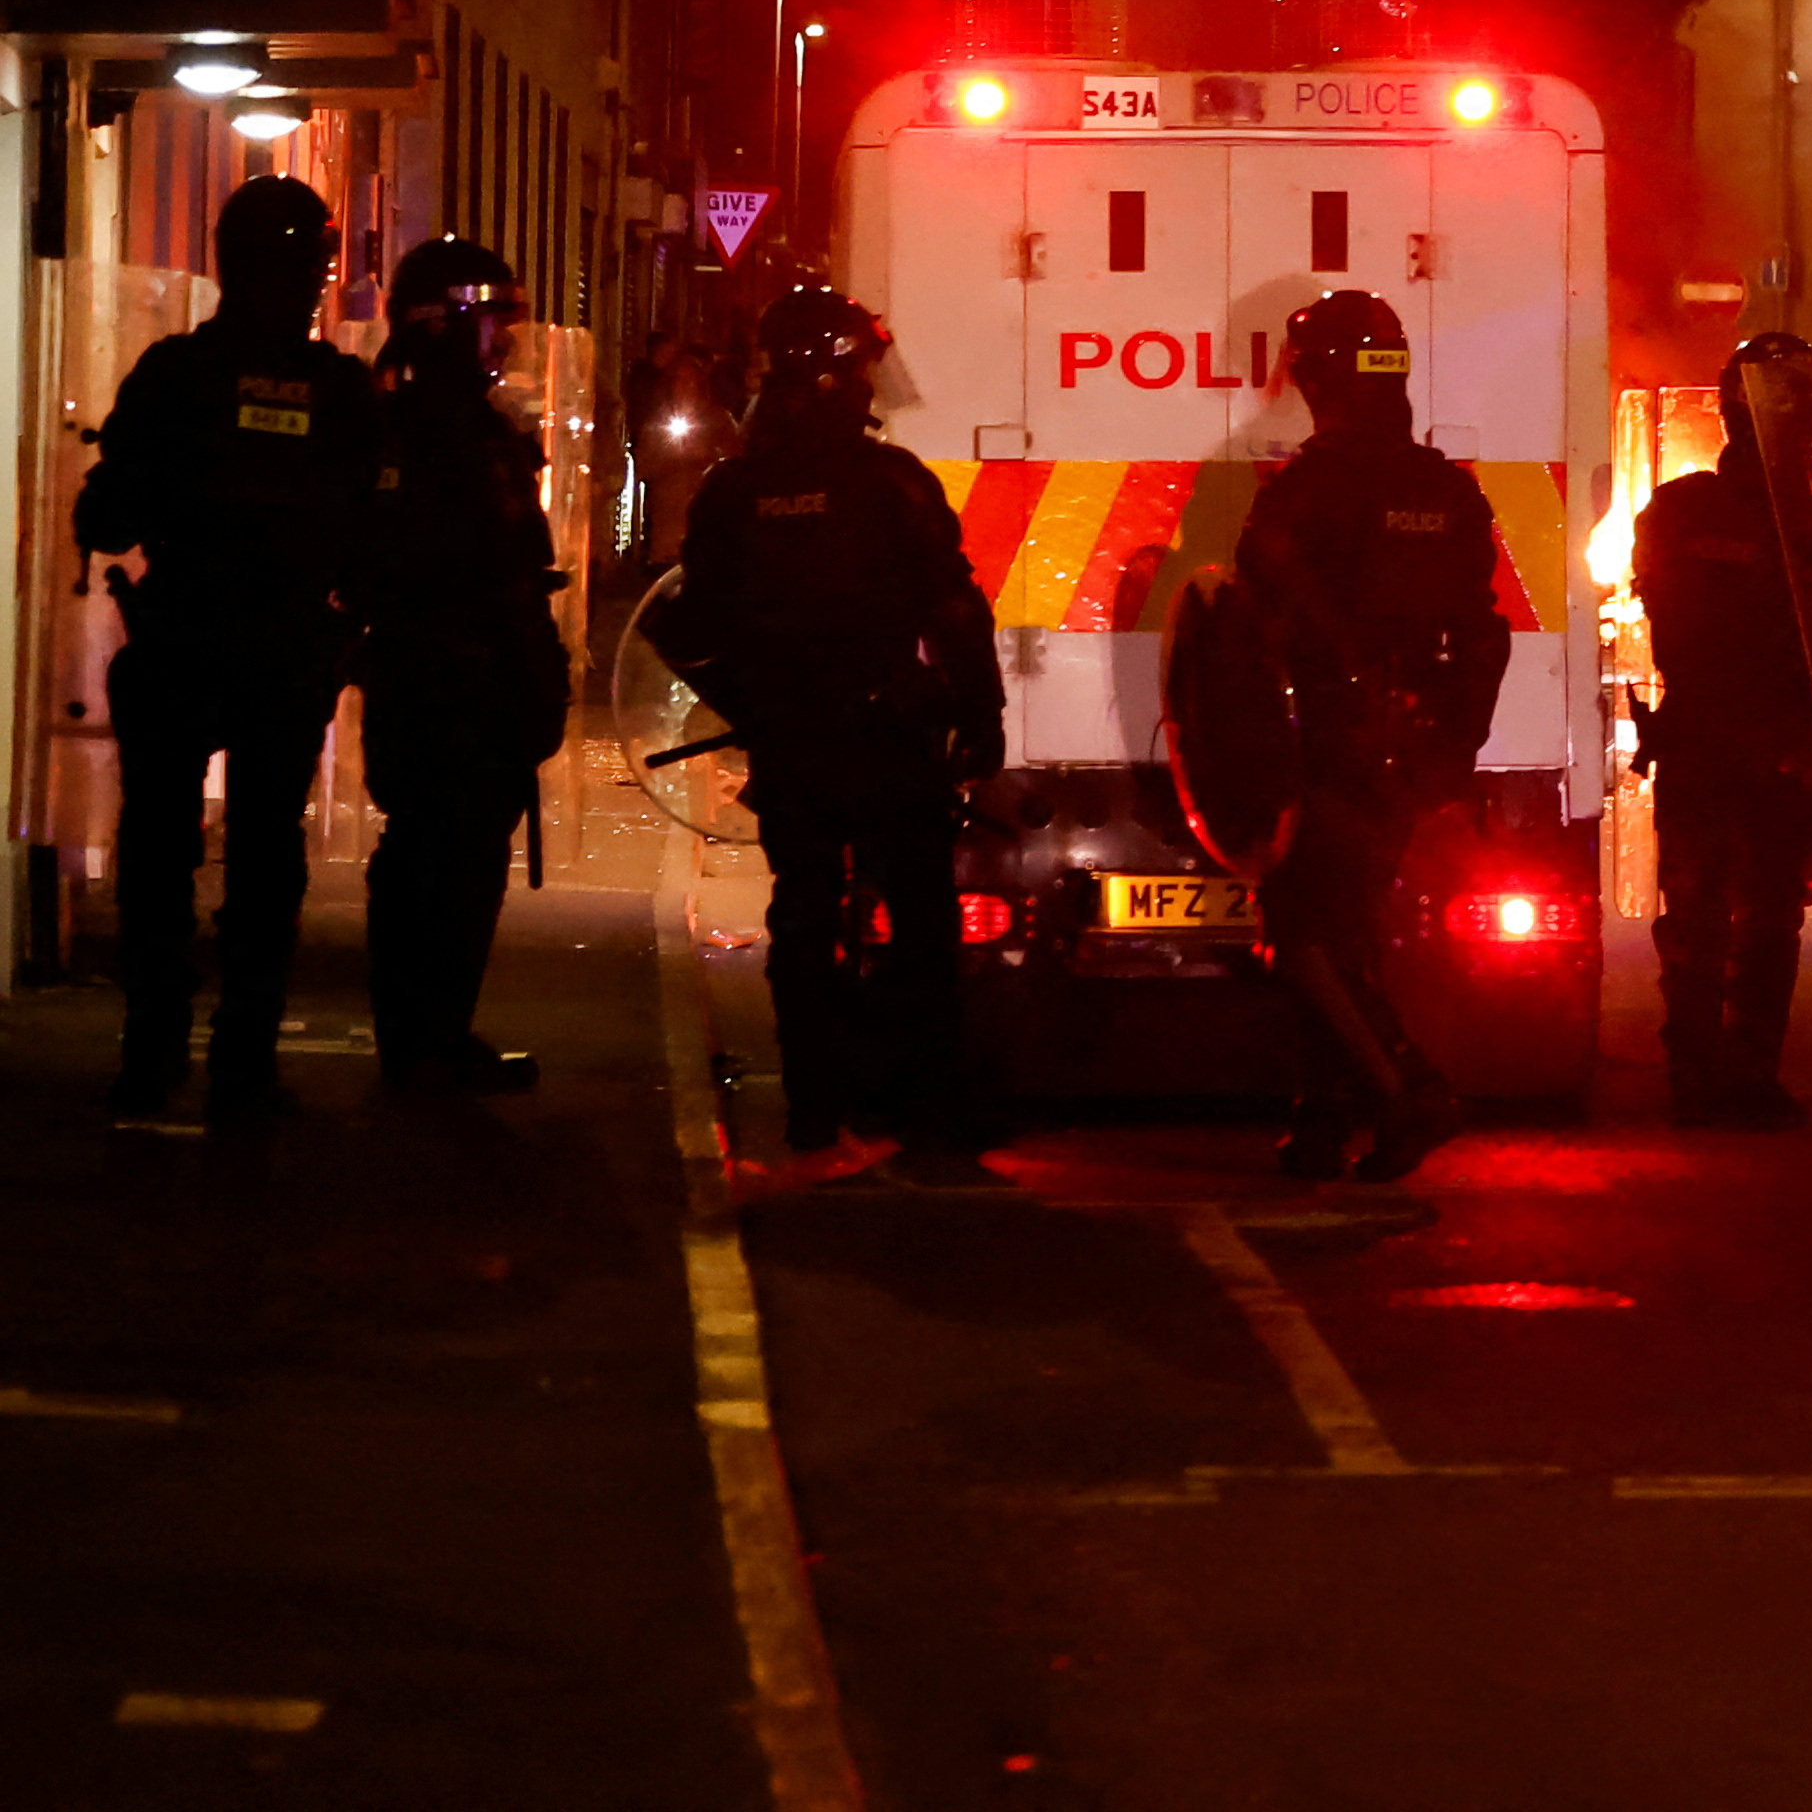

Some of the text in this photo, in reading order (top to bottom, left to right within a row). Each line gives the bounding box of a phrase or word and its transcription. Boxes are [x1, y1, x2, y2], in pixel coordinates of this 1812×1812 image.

[1083, 91, 1157, 118] S43A
[1296, 83, 1417, 114] POLICE
[708, 194, 756, 212] GIVE
[717, 216, 748, 226] WAY
[1061, 331, 1267, 389] POLI
[1130, 883, 1247, 918] MFZ 2
